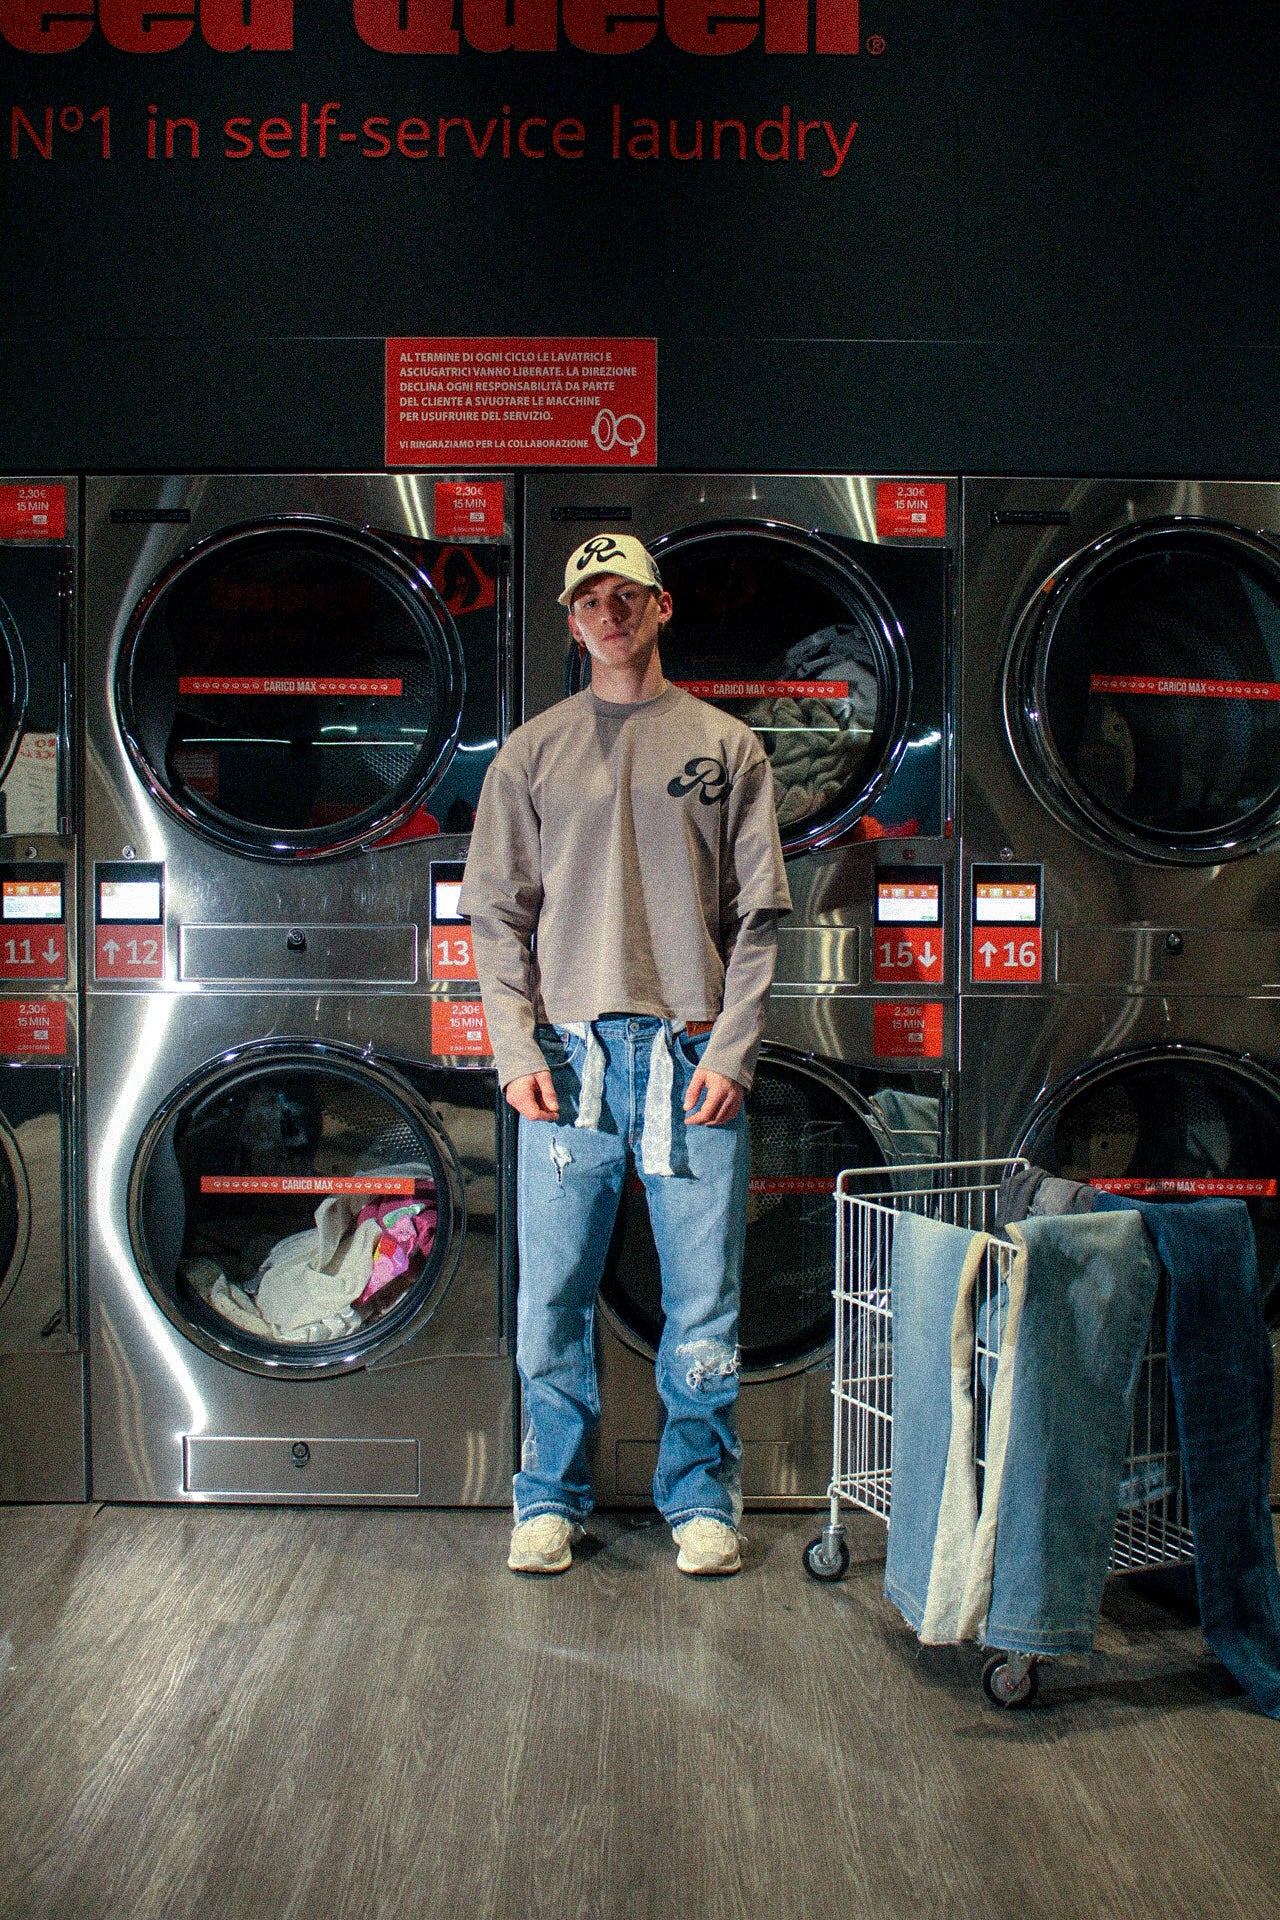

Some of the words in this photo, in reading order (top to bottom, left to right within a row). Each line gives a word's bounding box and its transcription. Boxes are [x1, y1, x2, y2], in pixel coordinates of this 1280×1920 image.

[147, 104, 199, 159] in
[224, 102, 586, 159] self-service
[613, 104, 859, 177] laundry
[399, 352, 413, 363] AL
[414, 352, 460, 363] TERMINE
[462, 352, 474, 363] DI
[475, 352, 503, 363] OGNI
[504, 351, 535, 362] CICLO
[536, 352, 549, 362] LE
[551, 352, 604, 362] LAVATRICI
[605, 352, 612, 362] E
[399, 366, 472, 377] ASCIUGATRICI
[472, 366, 511, 377] VANNO
[512, 366, 565, 377] LIBERATE.
[566, 366, 580, 377] LA
[581, 366, 637, 377] DIREZIONE
[399, 381, 444, 392] DECLINA
[445, 381, 474, 392] OGNI
[475, 379, 563, 392] RESPONSABILITÀ
[564, 381, 581, 392] DA
[582, 381, 615, 391] PARTE
[399, 396, 419, 407] DEL
[420, 396, 463, 407] CLIENTE
[464, 396, 473, 407] A
[474, 396, 530, 407] SVUOTARE
[531, 396, 544, 406] LE
[545, 396, 601, 406] MACCHINE
[399, 411, 419, 422] PER
[420, 411, 479, 422] USUFRUIRE
[481, 410, 501, 422] DEL
[503, 410, 554, 421] SERVIZIO.
[399, 439, 410, 449] VI
[410, 439, 475, 449] RINGRAZIAMO
[475, 439, 493, 449] PER
[494, 439, 506, 448] LA
[507, 439, 590, 449] COLLABORAZIONE
[453, 499, 463, 509] 15
[465, 499, 487, 509] MIN
[895, 500, 905, 509] 15
[906, 500, 928, 509] MIN
[264, 680, 295, 691] CARICO
[297, 681, 317, 691] MAX
[713, 684, 744, 695] CARICO
[746, 684, 766, 695] MAX
[1157, 680, 1187, 692] CARICO
[1188, 682, 1206, 693] MAX
[4, 938, 36, 965] 11
[126, 939, 159, 966] 12
[437, 940, 470, 966] 13
[879, 941, 914, 968] 15
[1003, 940, 1036, 968] 16
[29, 1016, 50, 1026] MIN
[450, 1018, 460, 1028] 15
[462, 1018, 483, 1028] MIN
[282, 1179, 313, 1190] CARICO
[314, 1180, 333, 1191] MAX
[1144, 1181, 1175, 1191] CARICO
[1176, 1181, 1196, 1192] MAX
